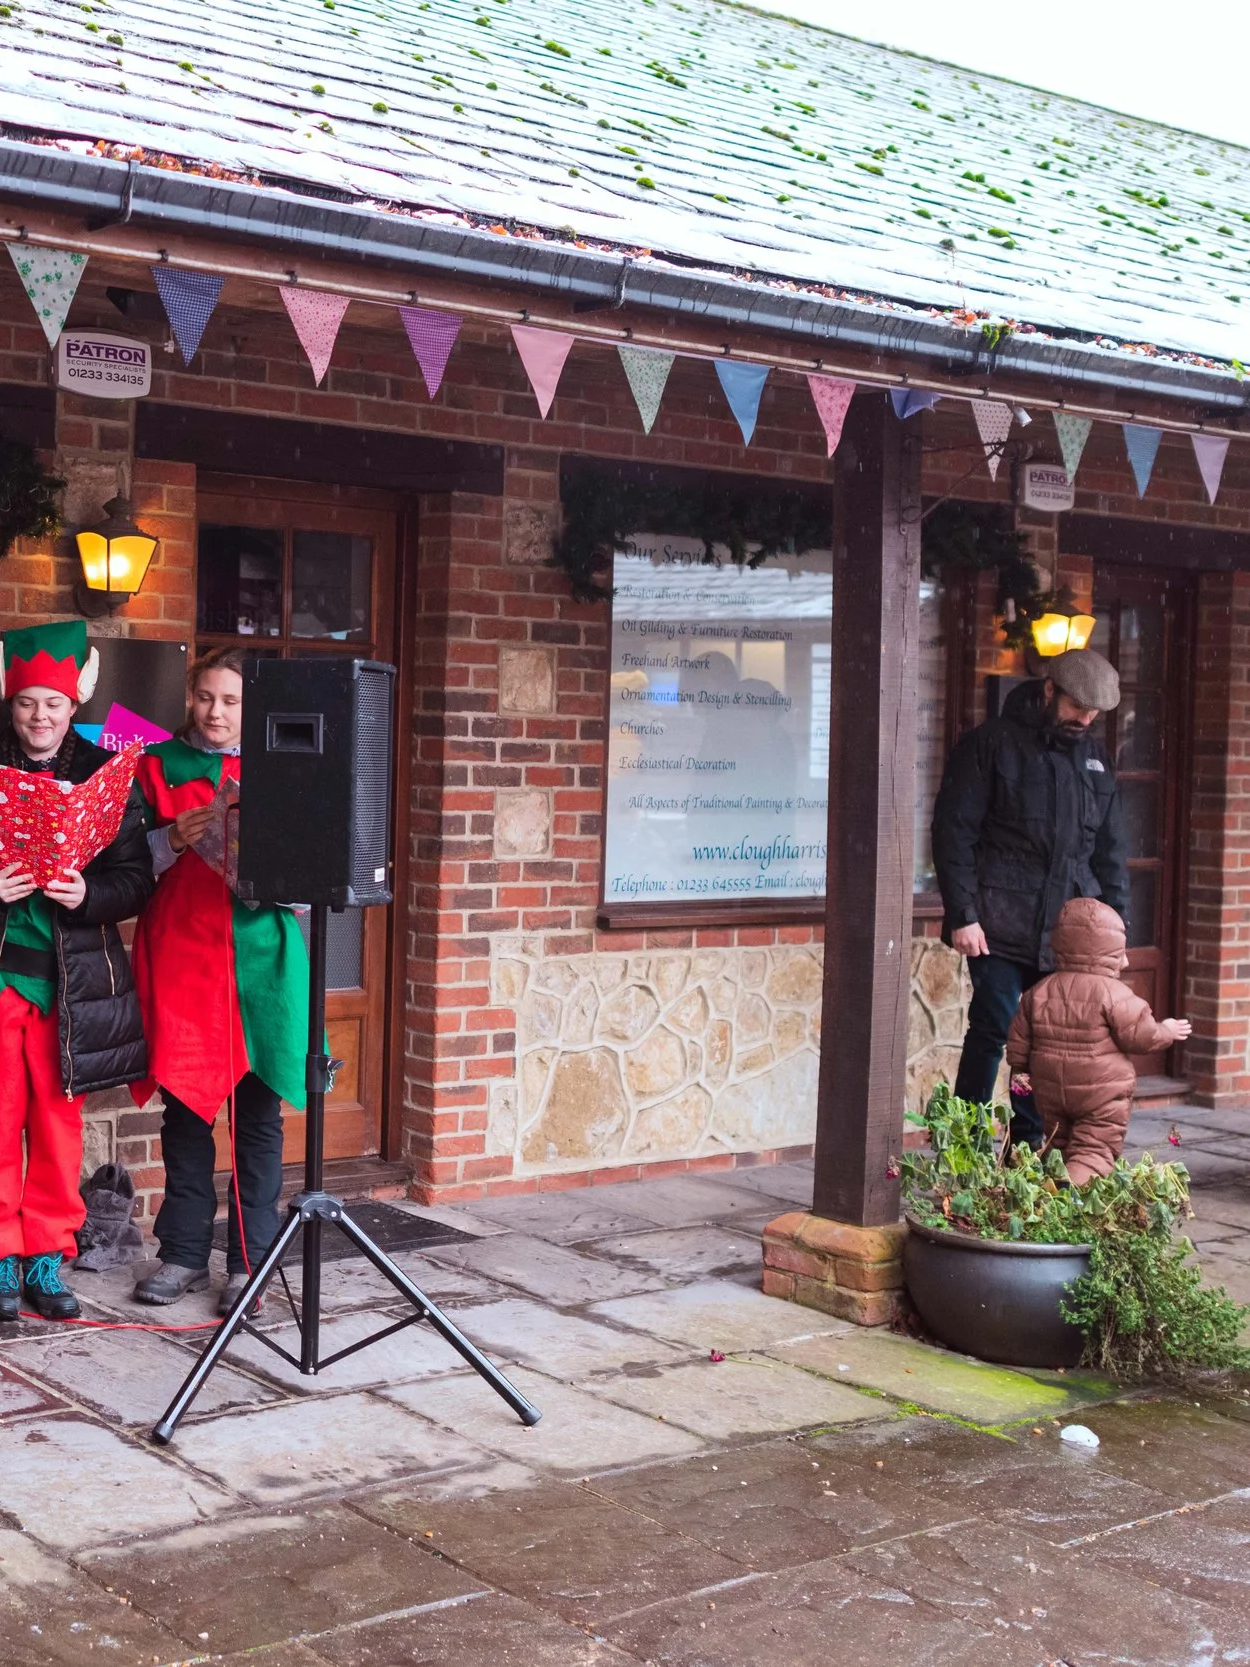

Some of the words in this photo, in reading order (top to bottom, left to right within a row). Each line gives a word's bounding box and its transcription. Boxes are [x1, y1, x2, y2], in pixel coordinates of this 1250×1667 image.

[66, 342, 146, 364] PATRON
[66, 359, 103, 368] SECURITY
[104, 363, 147, 374] SPECIALISTS
[68, 368, 103, 380] 01233
[105, 372, 145, 386] 334135
[1030, 471, 1067, 485] PATRO
[624, 541, 657, 561] Our
[622, 585, 680, 600] Restoration
[696, 590, 756, 606] Conservation
[621, 618, 637, 633] Oil
[639, 620, 676, 640] Gilding
[678, 622, 688, 635] &
[690, 622, 739, 638] Furniture
[741, 625, 793, 641] Restoration
[621, 652, 668, 668] Freehand
[670, 655, 711, 670] Artwork
[621, 687, 695, 703] Ornamentation
[697, 690, 730, 710] Design
[732, 691, 743, 705] &
[745, 692, 793, 712] Stencilling
[620, 719, 664, 736] Churches
[618, 752, 684, 769] Ecclesiastical
[685, 756, 737, 771] Decoration
[628, 794, 643, 809] All
[646, 796, 679, 813] Aspects
[680, 794, 692, 813] of
[692, 794, 745, 809] Traditional
[745, 796, 783, 814] Painting
[784, 796, 794, 809] &
[611, 873, 668, 899] Telephone
[677, 878, 709, 893] 01233
[712, 876, 751, 893] 645555
[754, 869, 789, 889] Email
